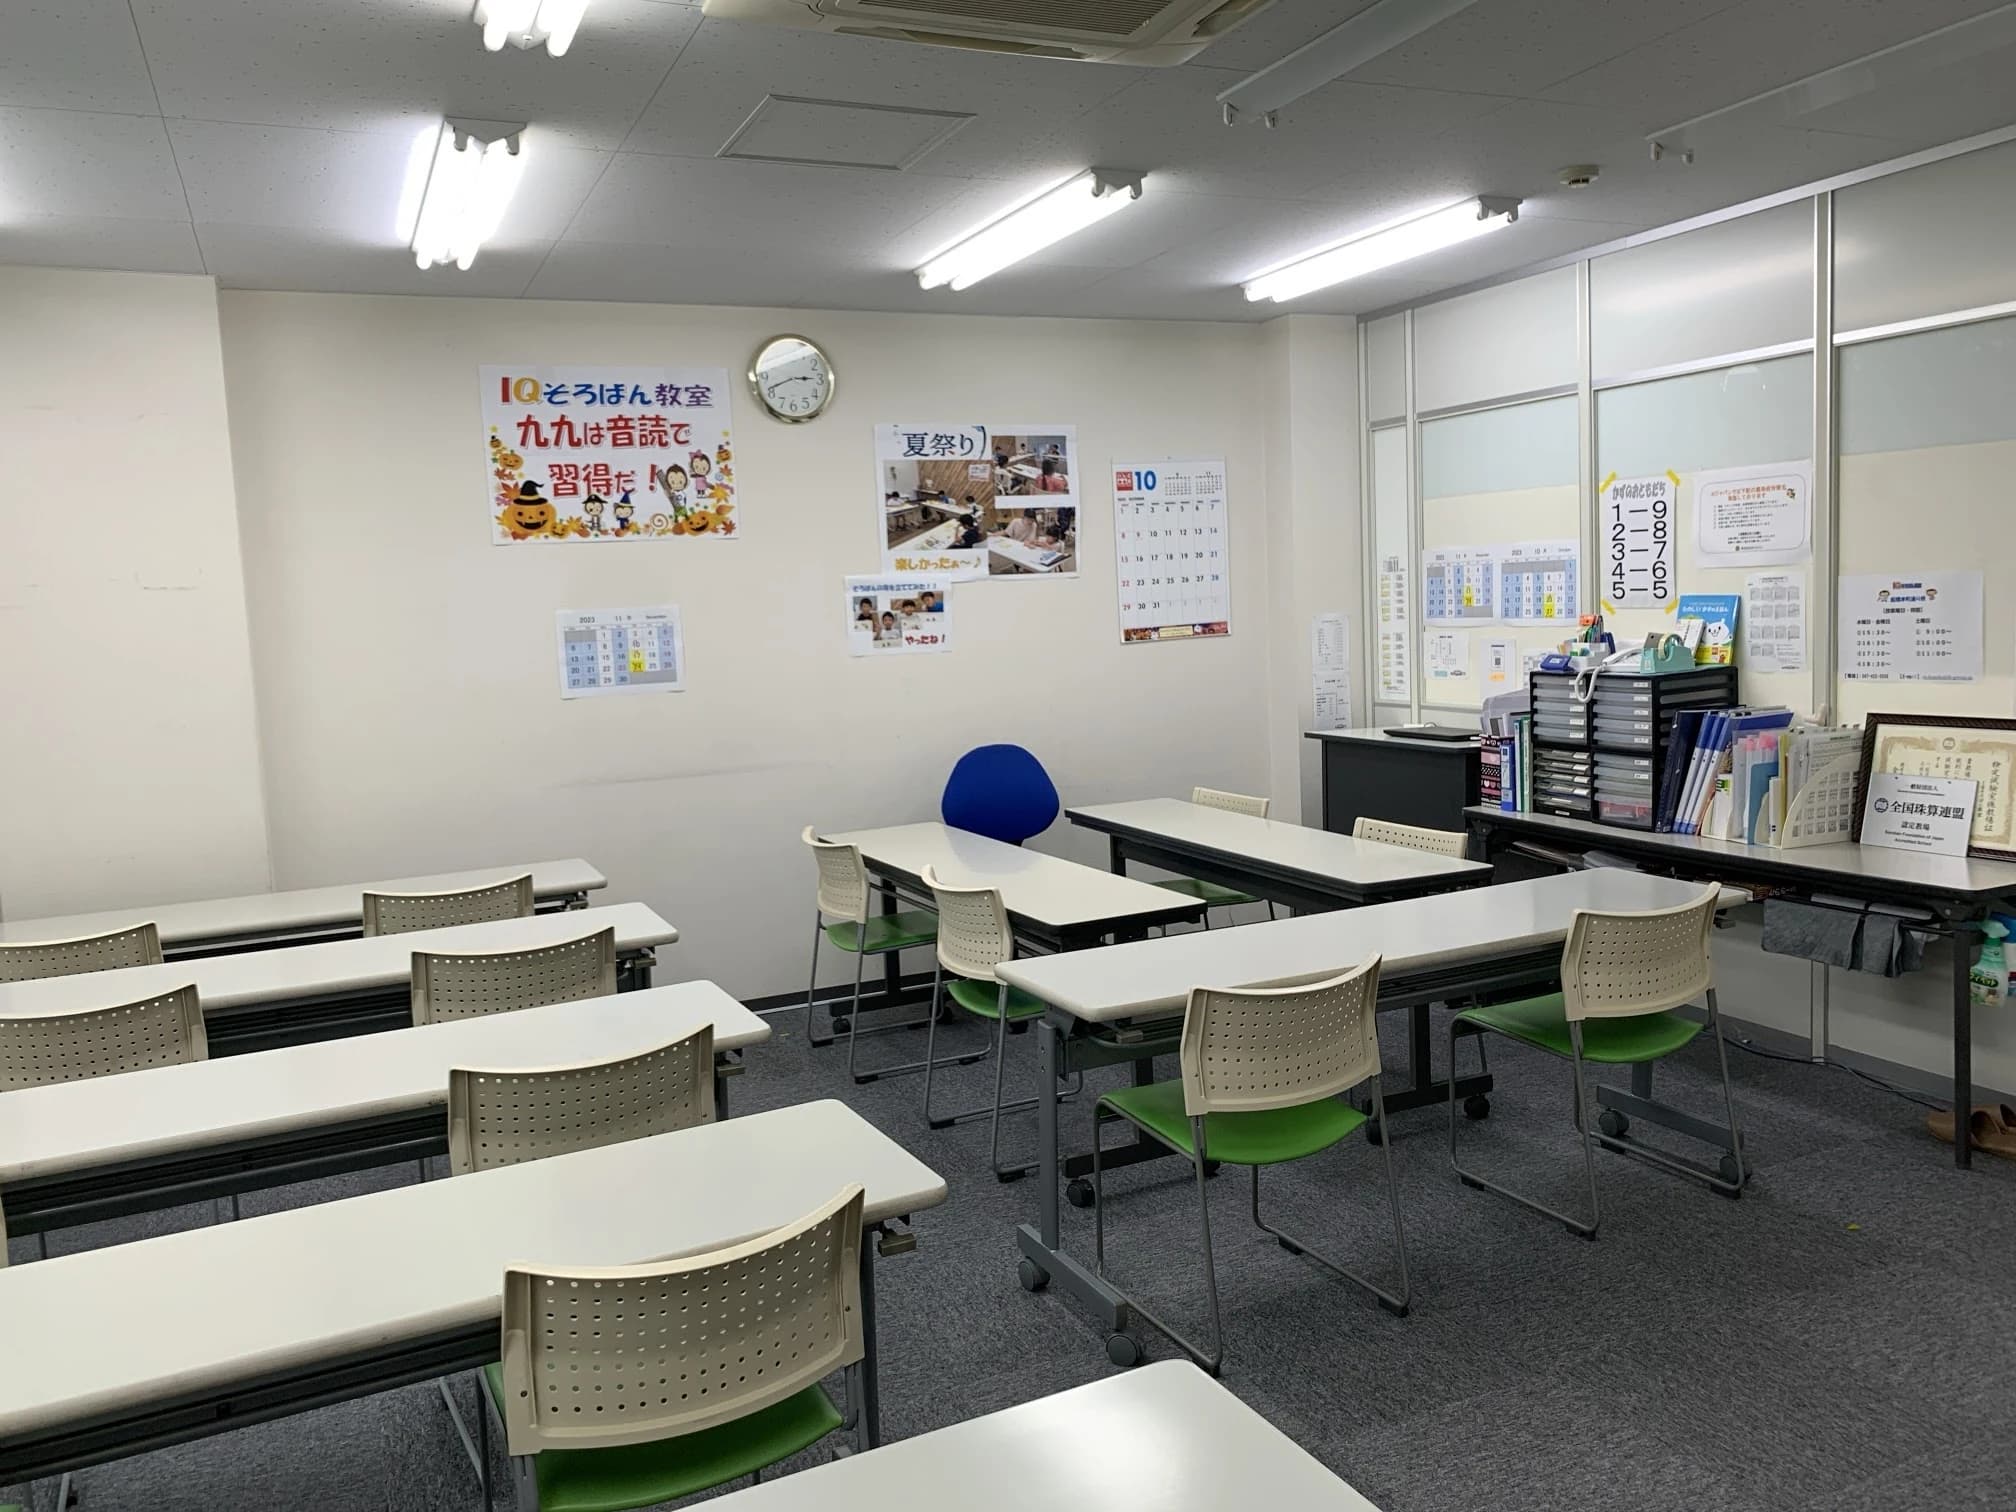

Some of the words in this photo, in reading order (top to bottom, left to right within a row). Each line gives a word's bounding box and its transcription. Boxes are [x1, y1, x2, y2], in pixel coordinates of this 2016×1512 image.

[810, 358, 818, 371] 2
[760, 371, 769, 383] 9
[816, 373, 824, 385] 3
[500, 376, 713, 407] IQそろばん教室
[768, 388, 776, 399] 8
[778, 396, 785, 408] 7
[790, 399, 798, 412] 6
[801, 397, 810, 409] 5
[517, 414, 690, 449] 九九は音読で
[902, 432, 974, 457] 夏祭り
[1134, 470, 1157, 491] 10
[1136, 531, 1141, 539] 9
[1150, 530, 1158, 538] 10
[1179, 529, 1187, 537] 12
[1194, 528, 1202, 536] 13
[1210, 527, 1218, 535] 14
[1121, 556, 1129, 564] 15
[1136, 555, 1144, 563] 16
[1166, 553, 1174, 561] 18
[1195, 551, 1204, 559] 20
[1122, 580, 1130, 588] 22
[1181, 576, 1189, 584] 26
[1196, 575, 1204, 583] 27
[1211, 574, 1219, 582] 28
[1889, 801, 1965, 820] 全国珠算連盟
